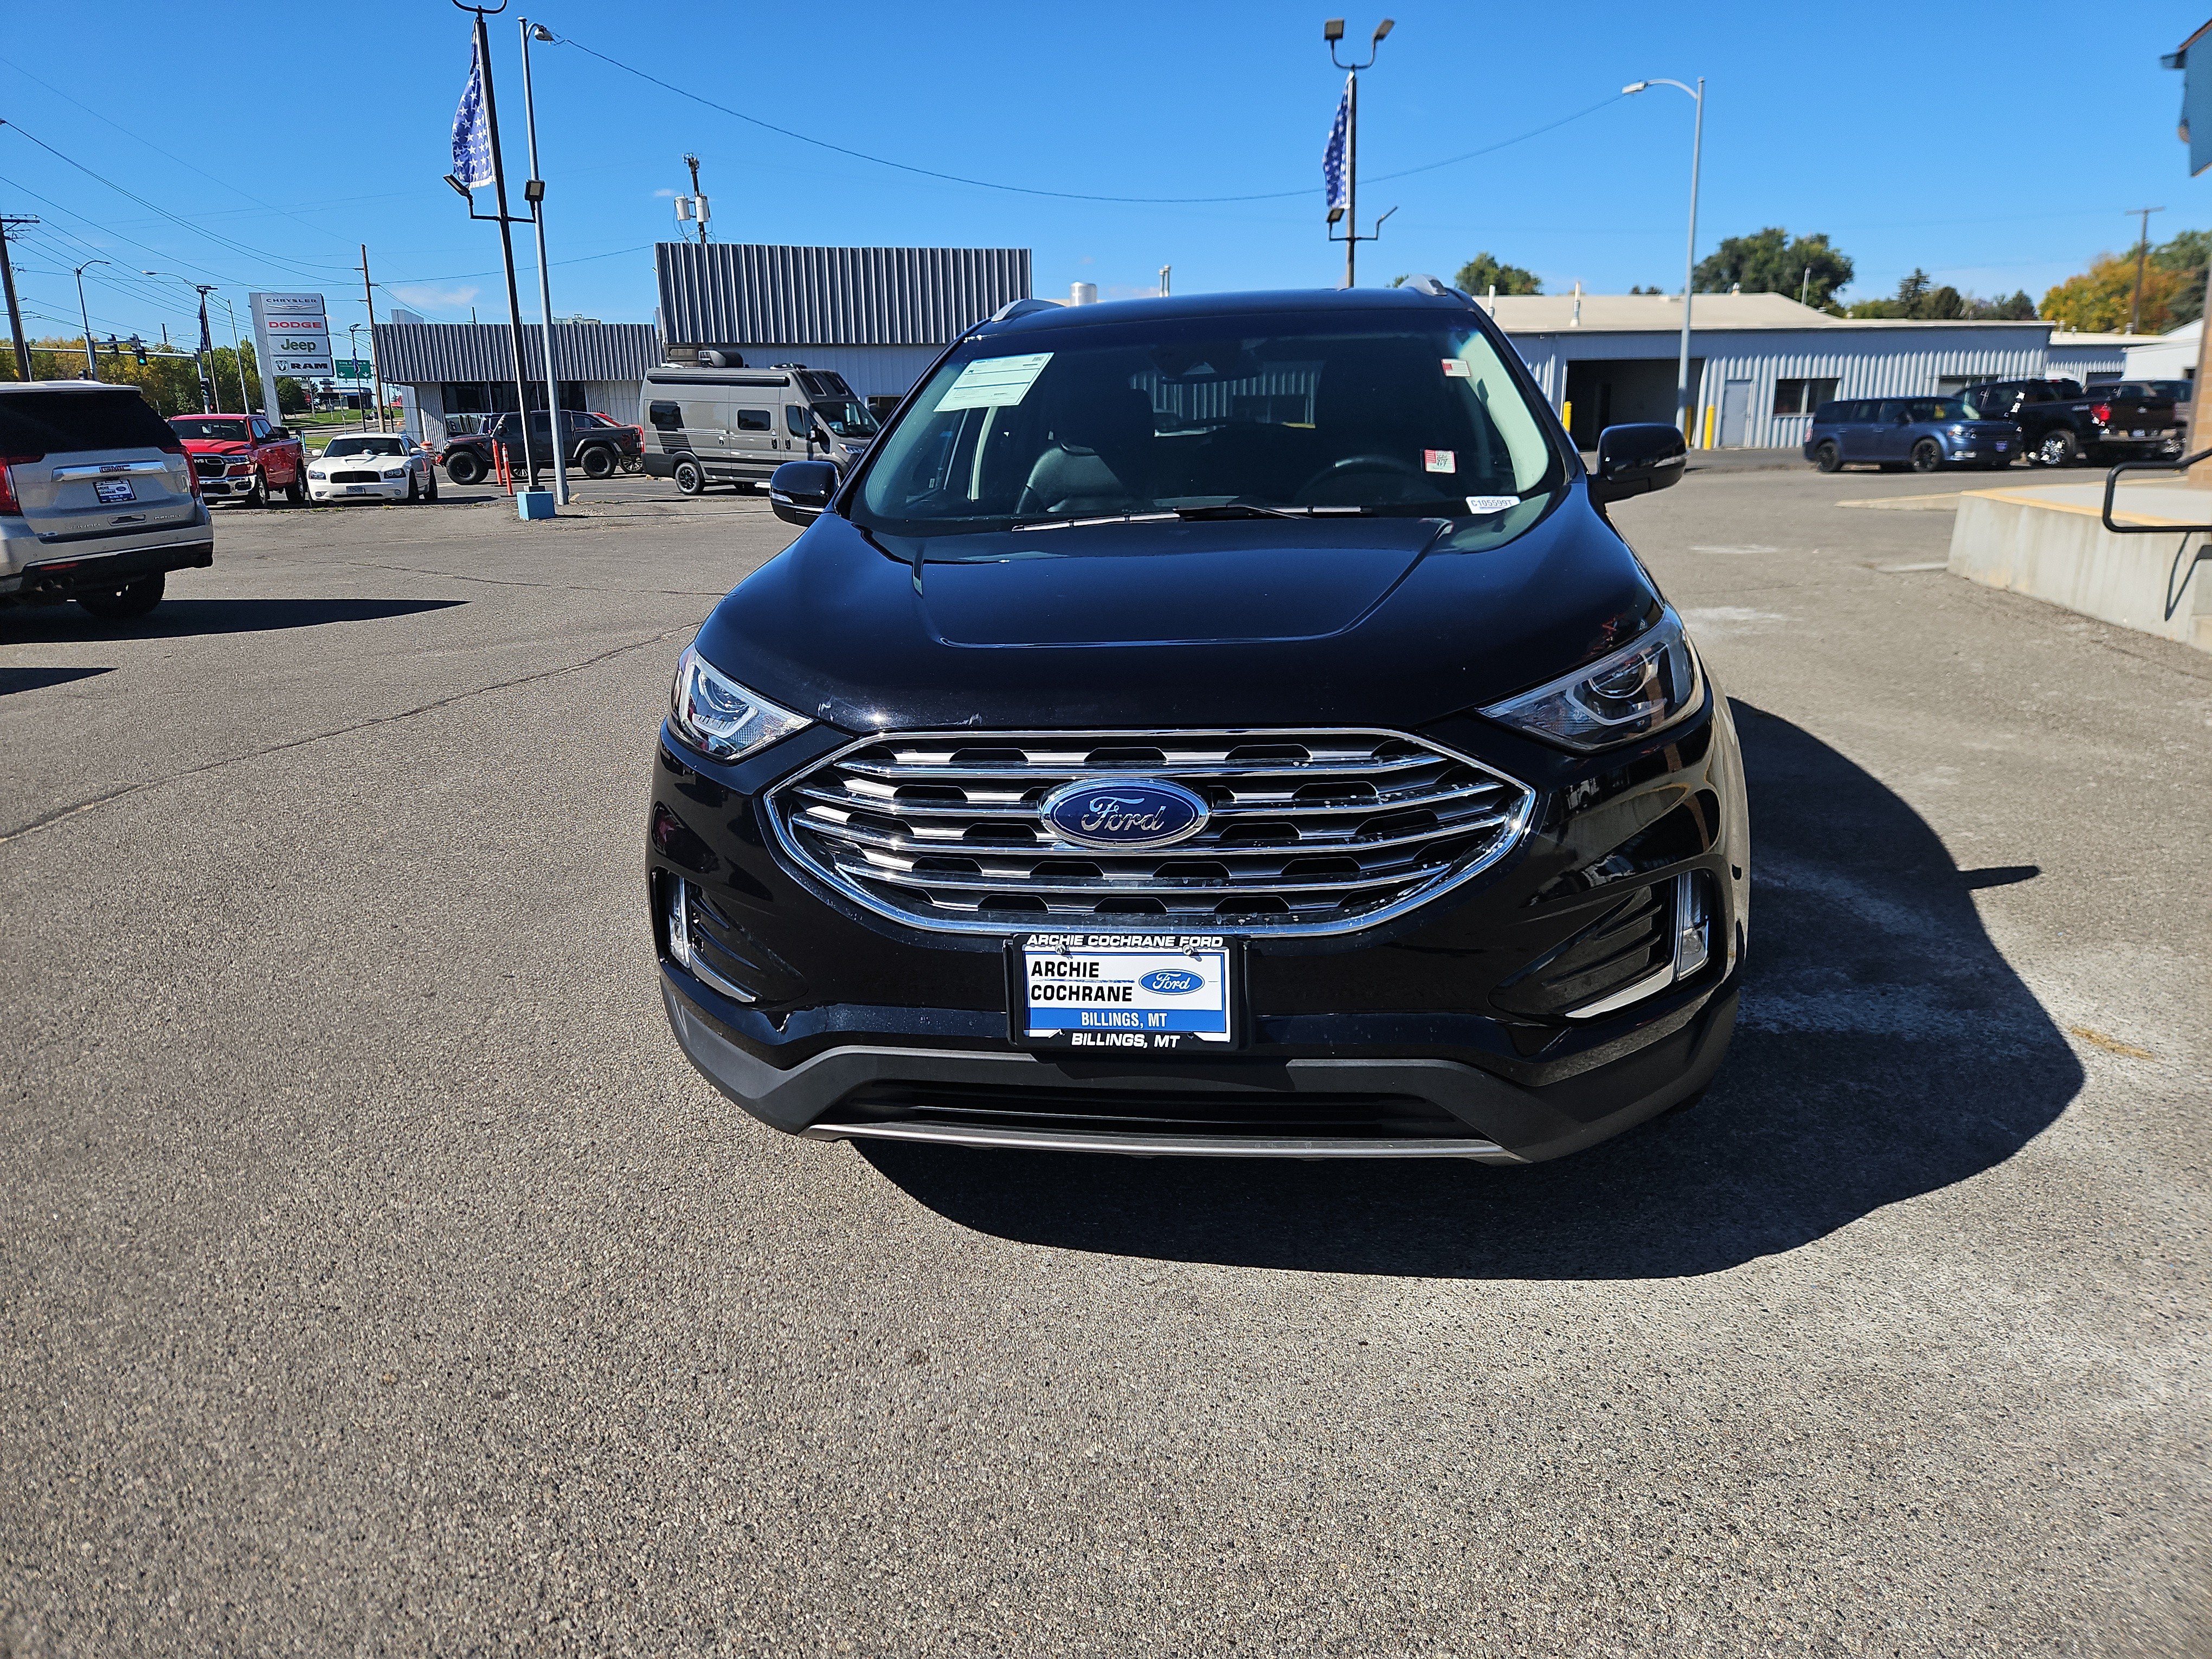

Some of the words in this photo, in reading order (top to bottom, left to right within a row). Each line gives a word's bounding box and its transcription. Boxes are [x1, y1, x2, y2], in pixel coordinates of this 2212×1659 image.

[280, 338, 316, 352] Jeep
[99, 465, 131, 473] GMC
[1081, 796, 1167, 831] Ford
[1027, 934, 1084, 946] ARCHIE
[1088, 935, 1174, 947] COCHRANE
[1179, 936, 1223, 948] FORD
[1031, 961, 1099, 978] ARCHIE
[1152, 973, 1190, 991] Ford
[1031, 985, 1133, 1002] COCHRANE
[1081, 1012, 1143, 1029] BILLINGS,
[1148, 1013, 1168, 1027] MT
[1071, 1033, 1148, 1049] BILLINGS,
[1154, 1034, 1181, 1048] MT
